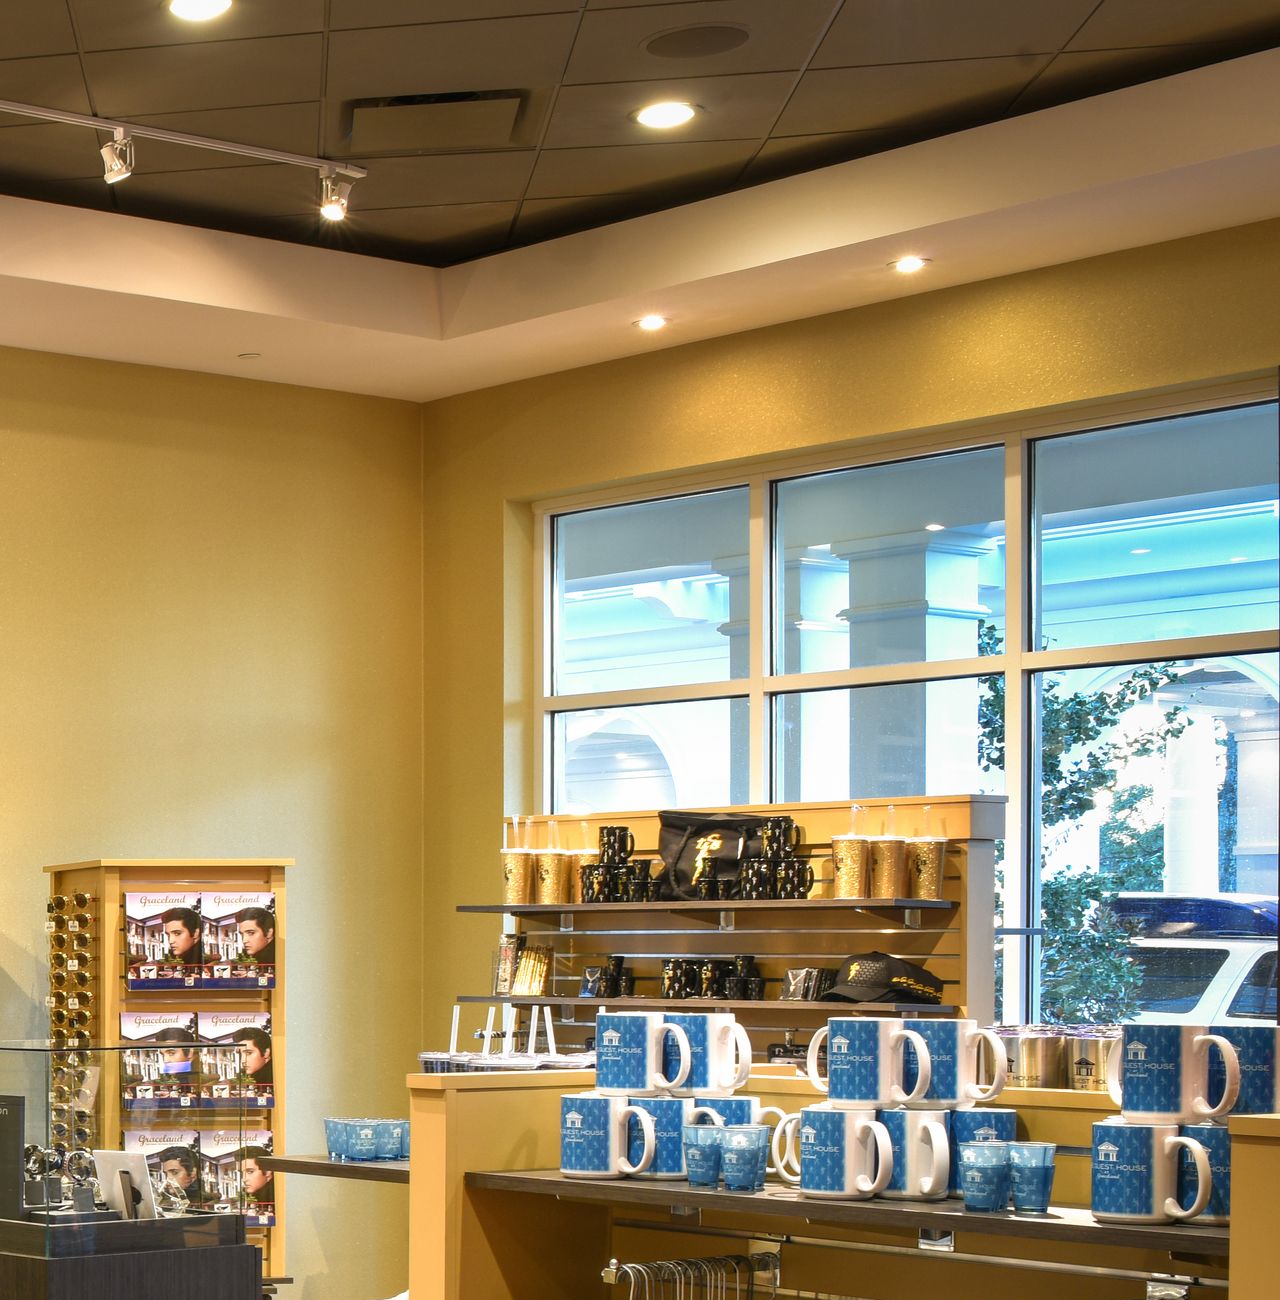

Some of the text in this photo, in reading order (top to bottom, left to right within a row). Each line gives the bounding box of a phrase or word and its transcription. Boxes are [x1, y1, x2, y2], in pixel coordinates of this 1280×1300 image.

[140, 895, 186, 907] Graceland
[213, 895, 260, 906] Graceland
[134, 1015, 179, 1027] Graceland
[211, 1015, 257, 1027] Graceland
[138, 1133, 183, 1146] Graceland
[813, 1145, 840, 1153] HOUSE
[1116, 1164, 1148, 1172] HOUSE
